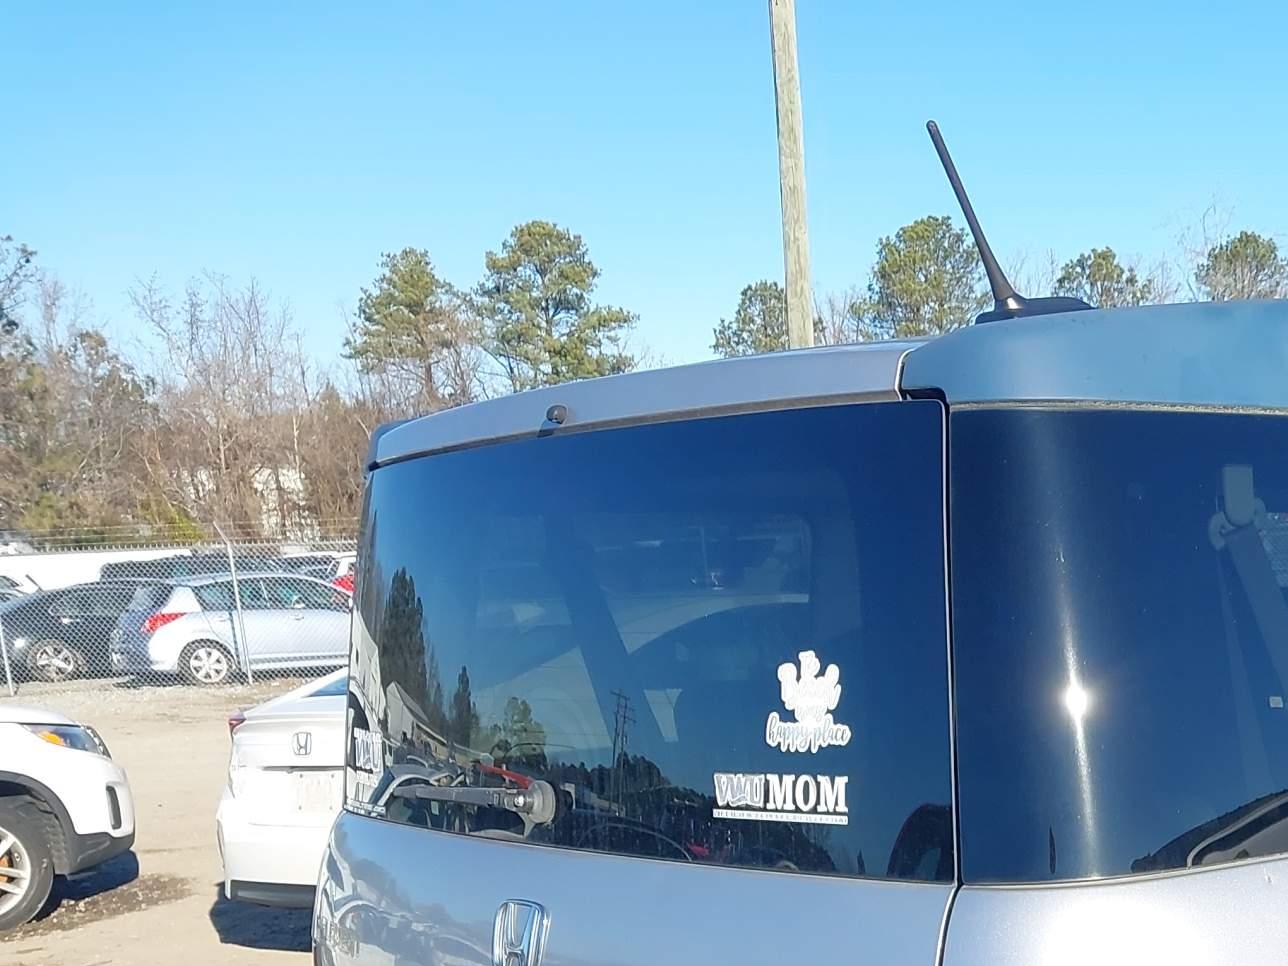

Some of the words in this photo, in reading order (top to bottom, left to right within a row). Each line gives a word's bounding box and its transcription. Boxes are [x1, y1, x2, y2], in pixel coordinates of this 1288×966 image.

[768, 713, 810, 751] happy
[811, 714, 850, 752] place
[766, 774, 848, 813] MOM
